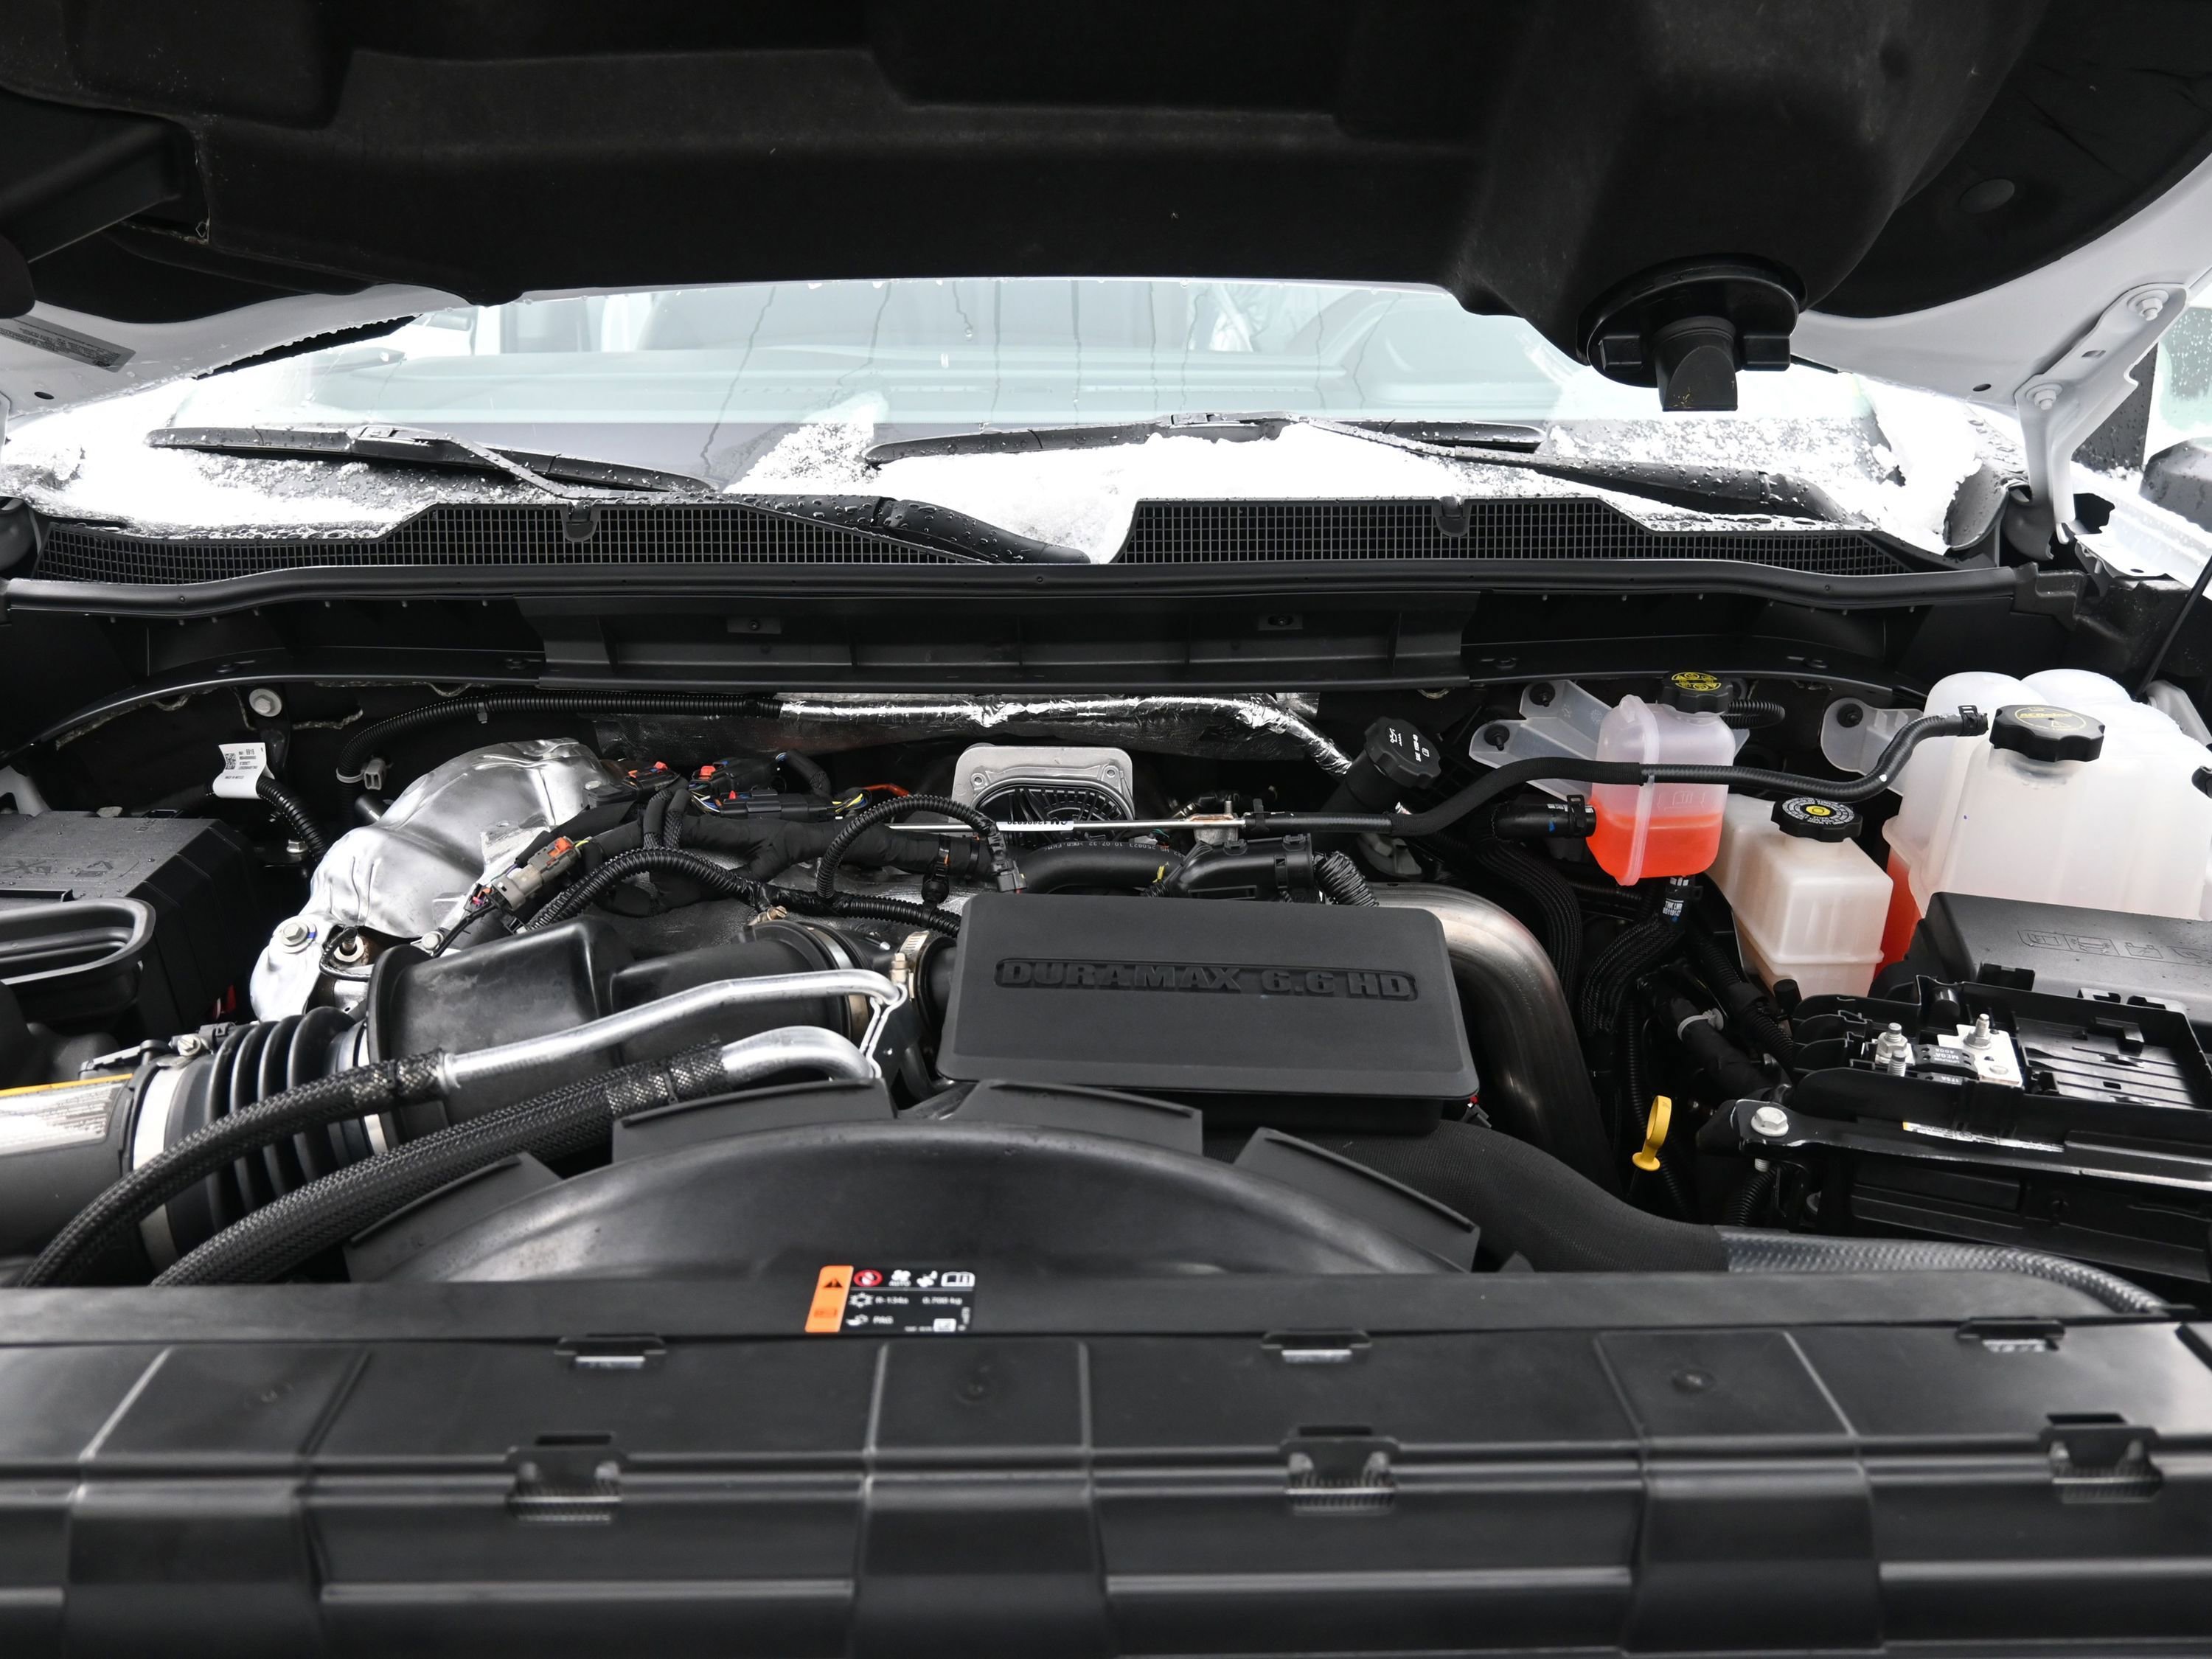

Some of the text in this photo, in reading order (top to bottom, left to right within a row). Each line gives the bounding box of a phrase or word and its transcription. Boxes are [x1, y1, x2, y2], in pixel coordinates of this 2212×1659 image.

[1001, 960, 1413, 1001] DURAMAX 6.6 HD
